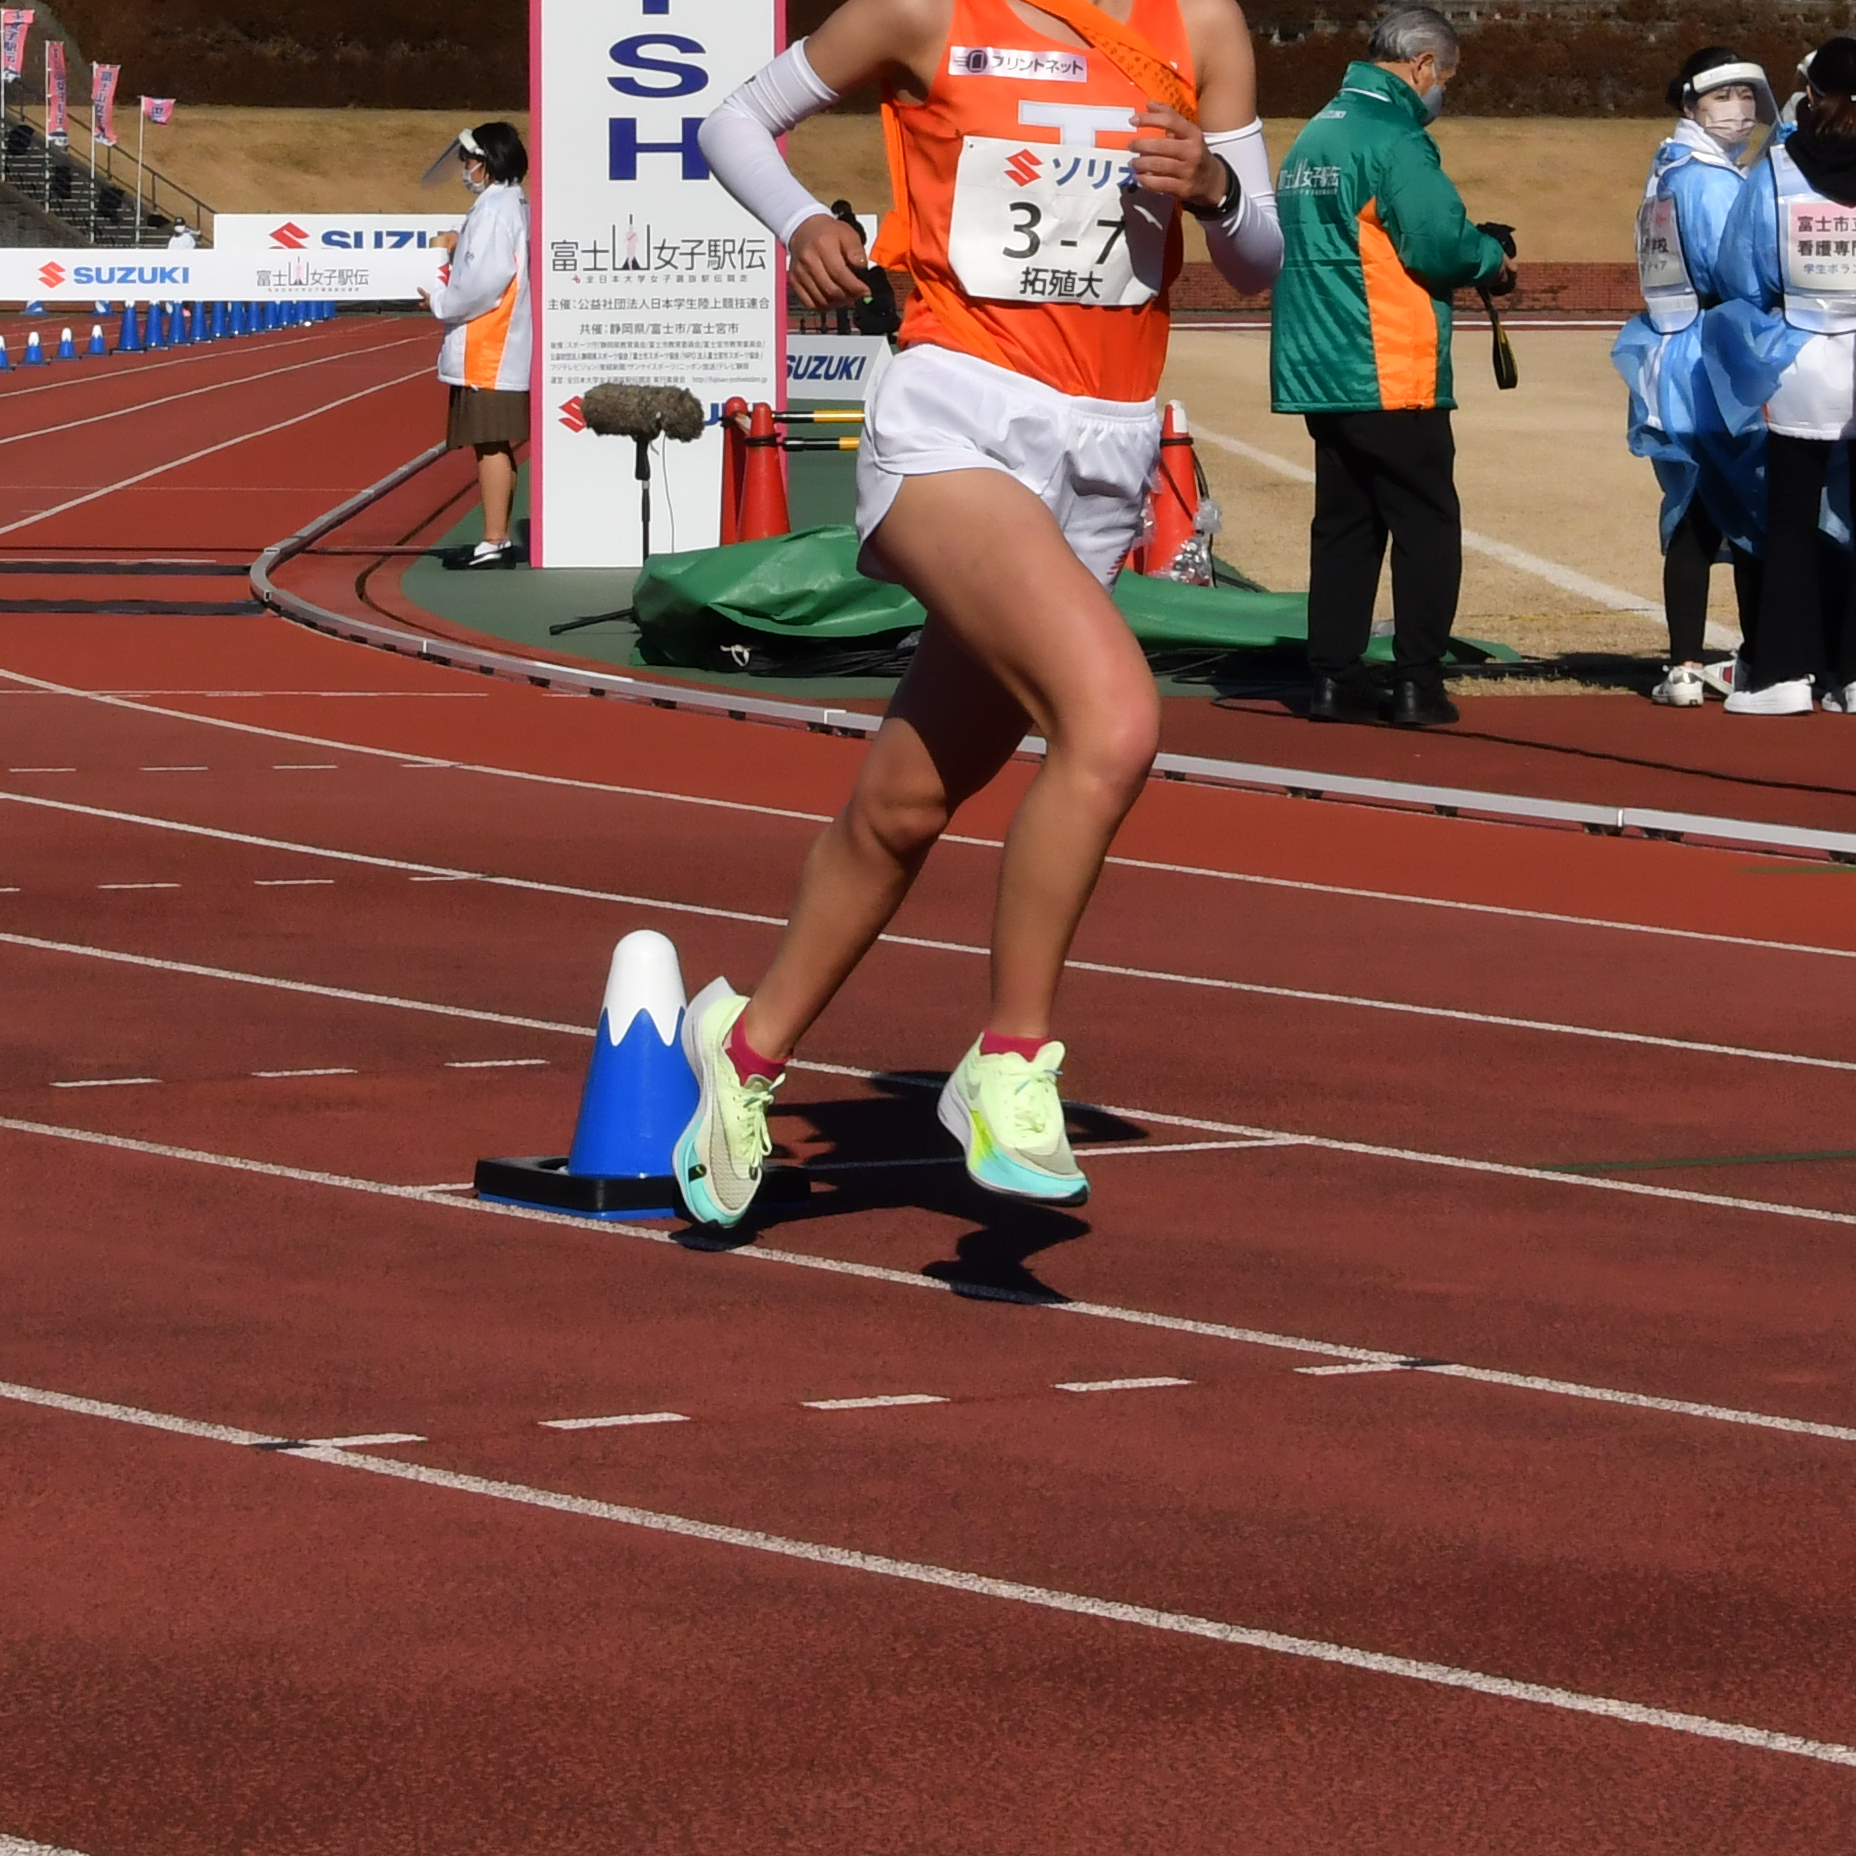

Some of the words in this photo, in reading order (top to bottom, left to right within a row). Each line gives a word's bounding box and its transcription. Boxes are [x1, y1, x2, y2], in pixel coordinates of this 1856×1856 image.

[550, 213, 767, 272] 富士山女子駅伝
[73, 265, 190, 285] SUZUKI
[1019, 266, 1104, 299] 拓殖大
[786, 355, 867, 380] SUZUKI
